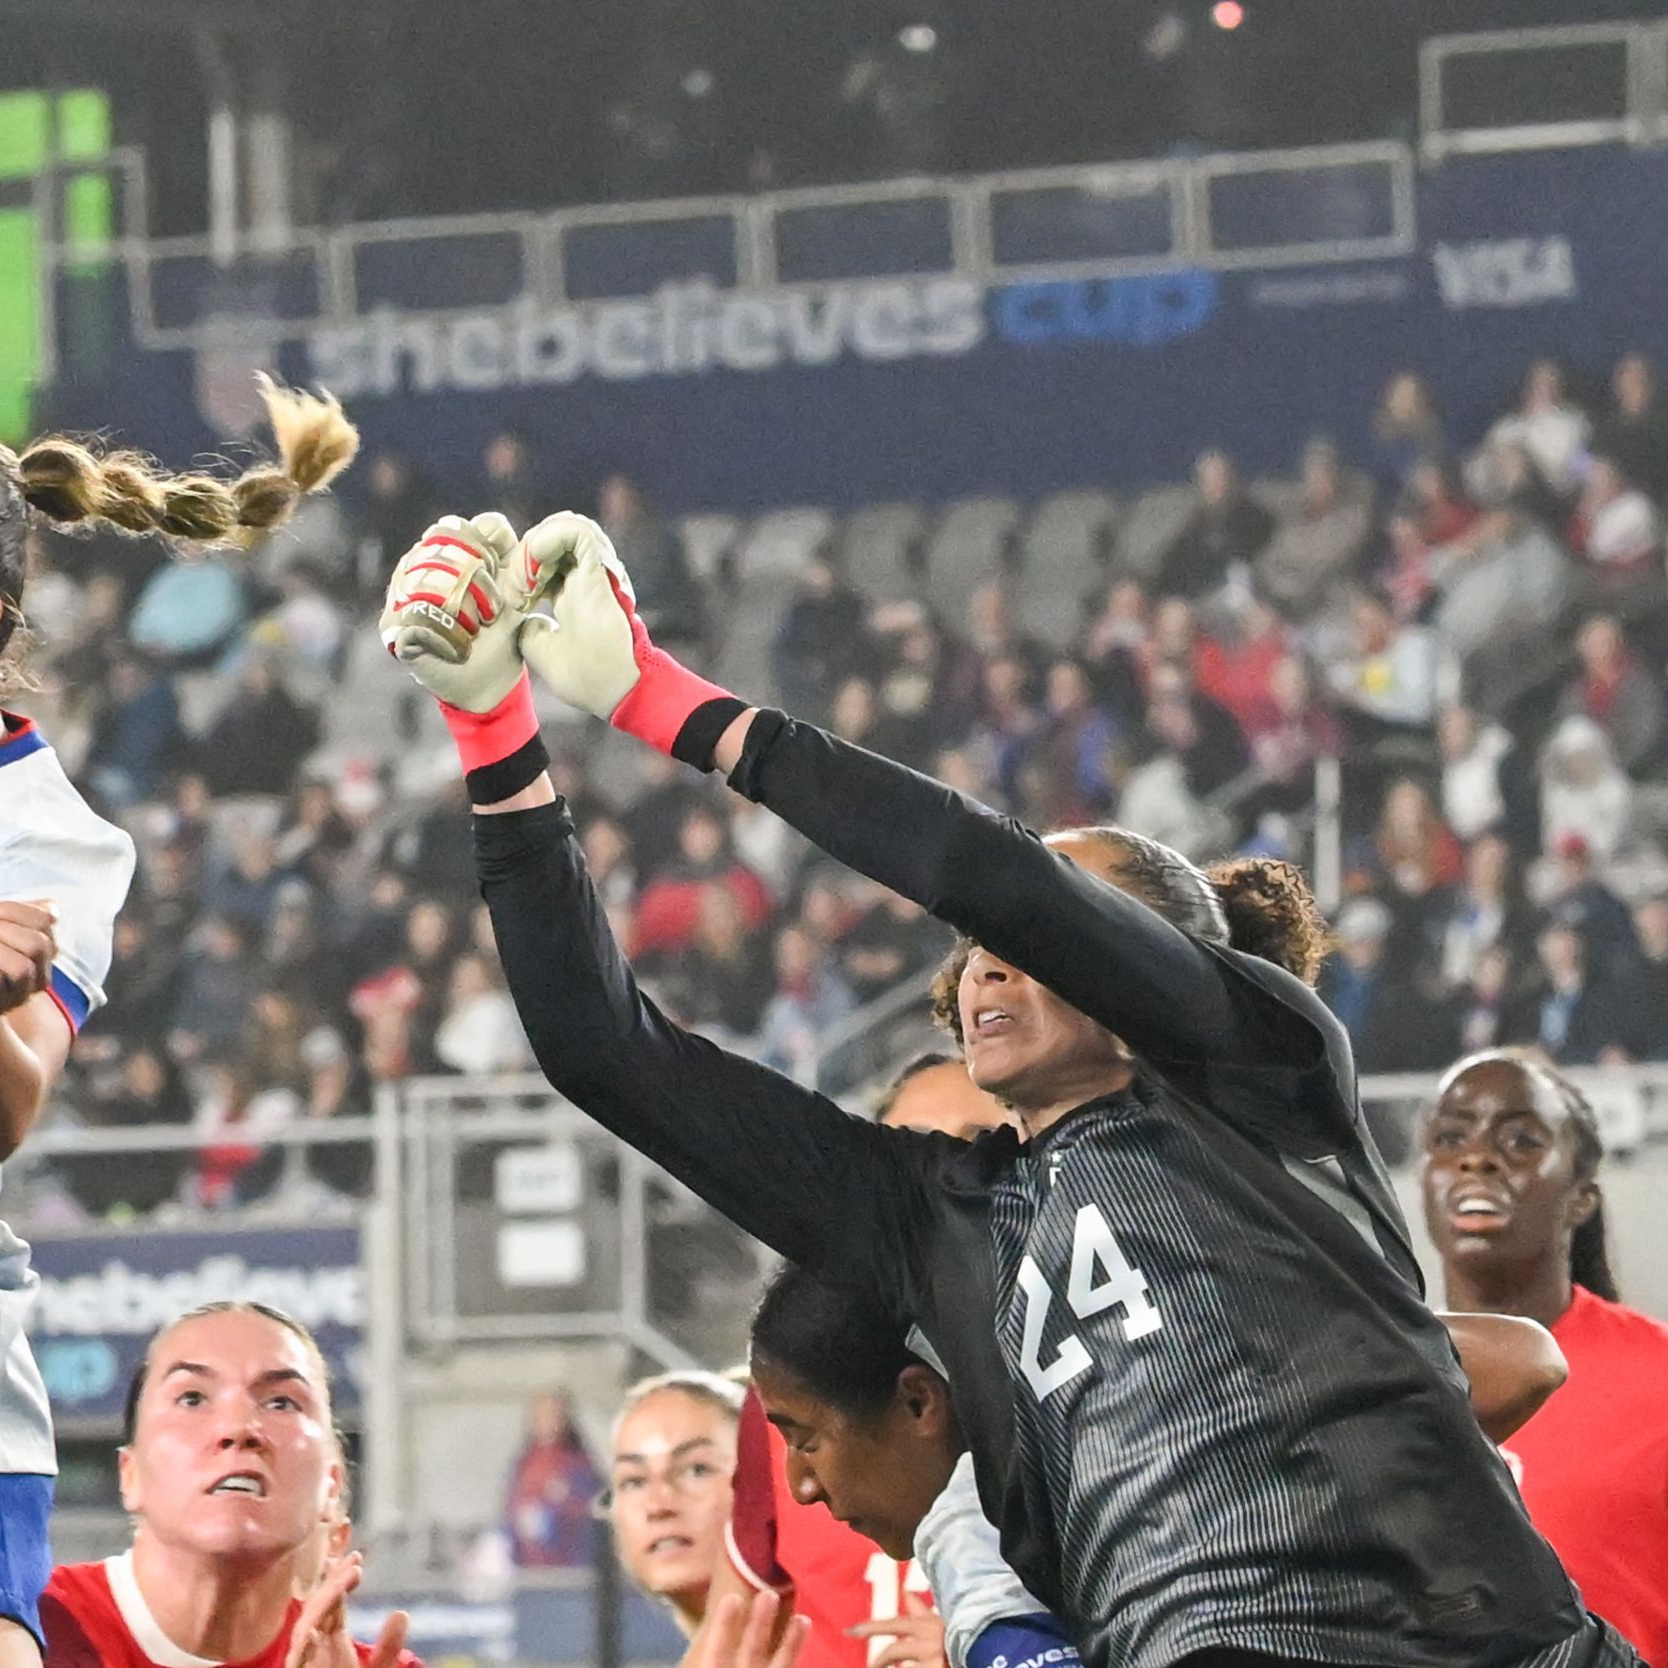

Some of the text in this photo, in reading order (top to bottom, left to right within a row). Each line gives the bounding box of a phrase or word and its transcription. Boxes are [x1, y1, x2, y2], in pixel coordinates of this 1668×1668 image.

[308, 275, 985, 397] shebelieves
[402, 600, 455, 630] PRED
[1016, 1202, 1163, 1403] 24
